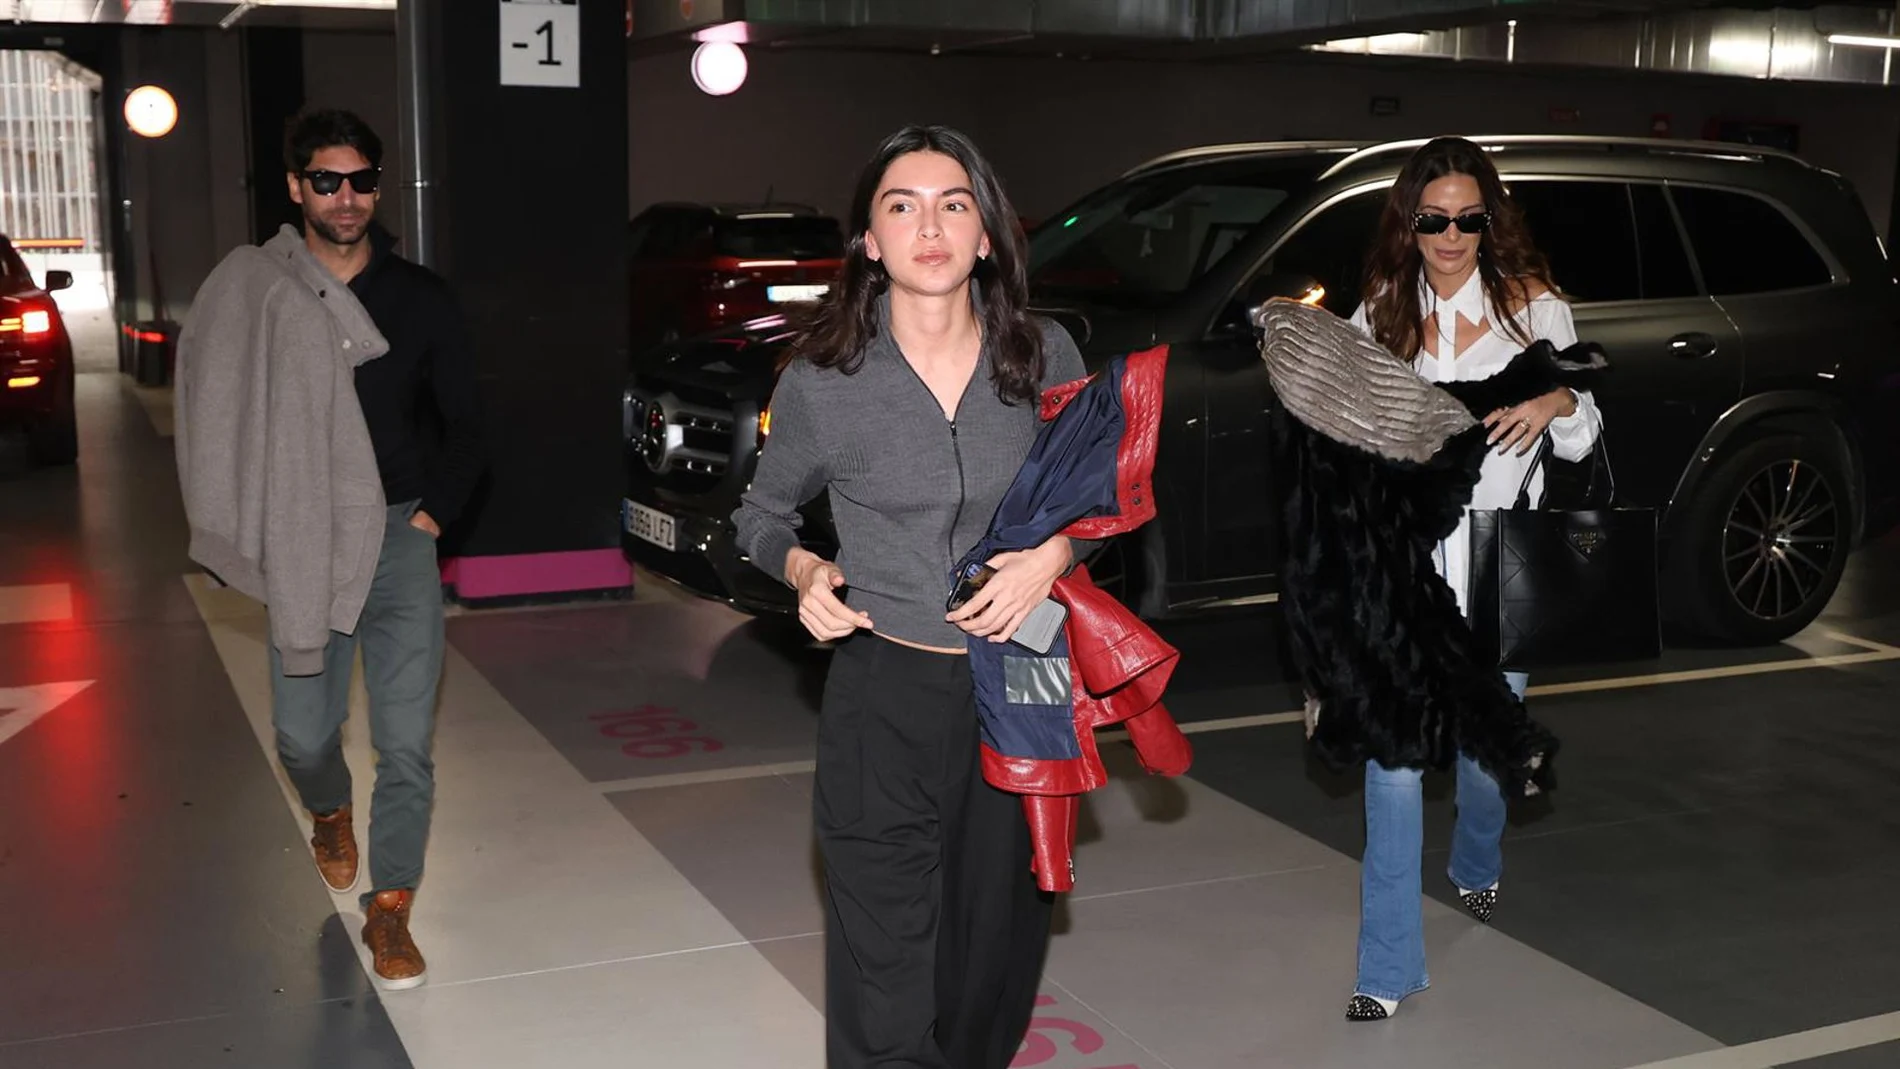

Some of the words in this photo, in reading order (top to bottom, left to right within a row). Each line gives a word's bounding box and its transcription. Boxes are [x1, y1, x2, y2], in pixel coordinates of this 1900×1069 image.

[512, 20, 561, 66] -1
[653, 516, 672, 546] LFZ
[588, 704, 724, 759] 166
